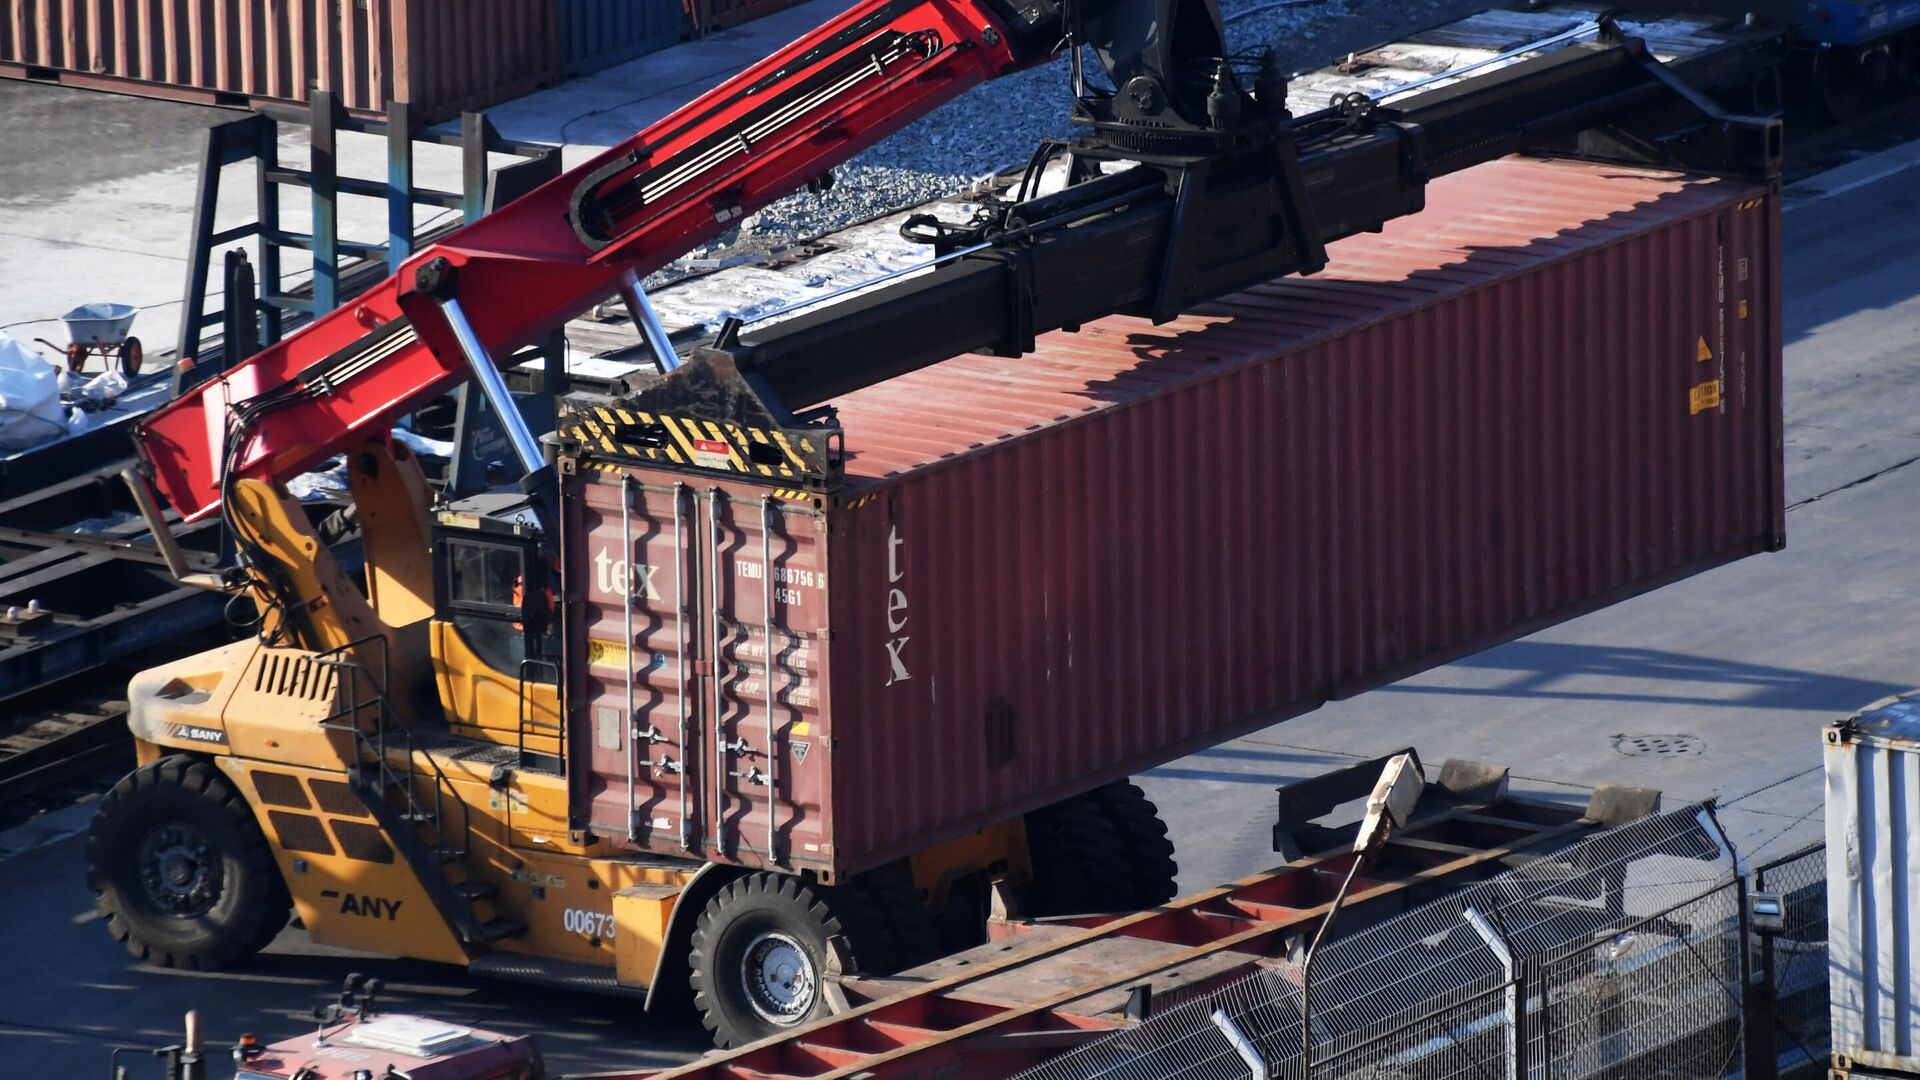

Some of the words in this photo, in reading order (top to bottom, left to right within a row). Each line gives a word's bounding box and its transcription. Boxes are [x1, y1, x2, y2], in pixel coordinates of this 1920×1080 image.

[595, 546, 662, 602] tex
[736, 560, 762, 579] TEMU
[774, 567, 814, 588] 686756
[817, 572, 825, 588] 6
[774, 588, 801, 606] 45G1
[885, 524, 912, 687] tex
[190, 729, 222, 741] SANY
[321, 890, 403, 921] ANY
[564, 908, 615, 939] 00673
